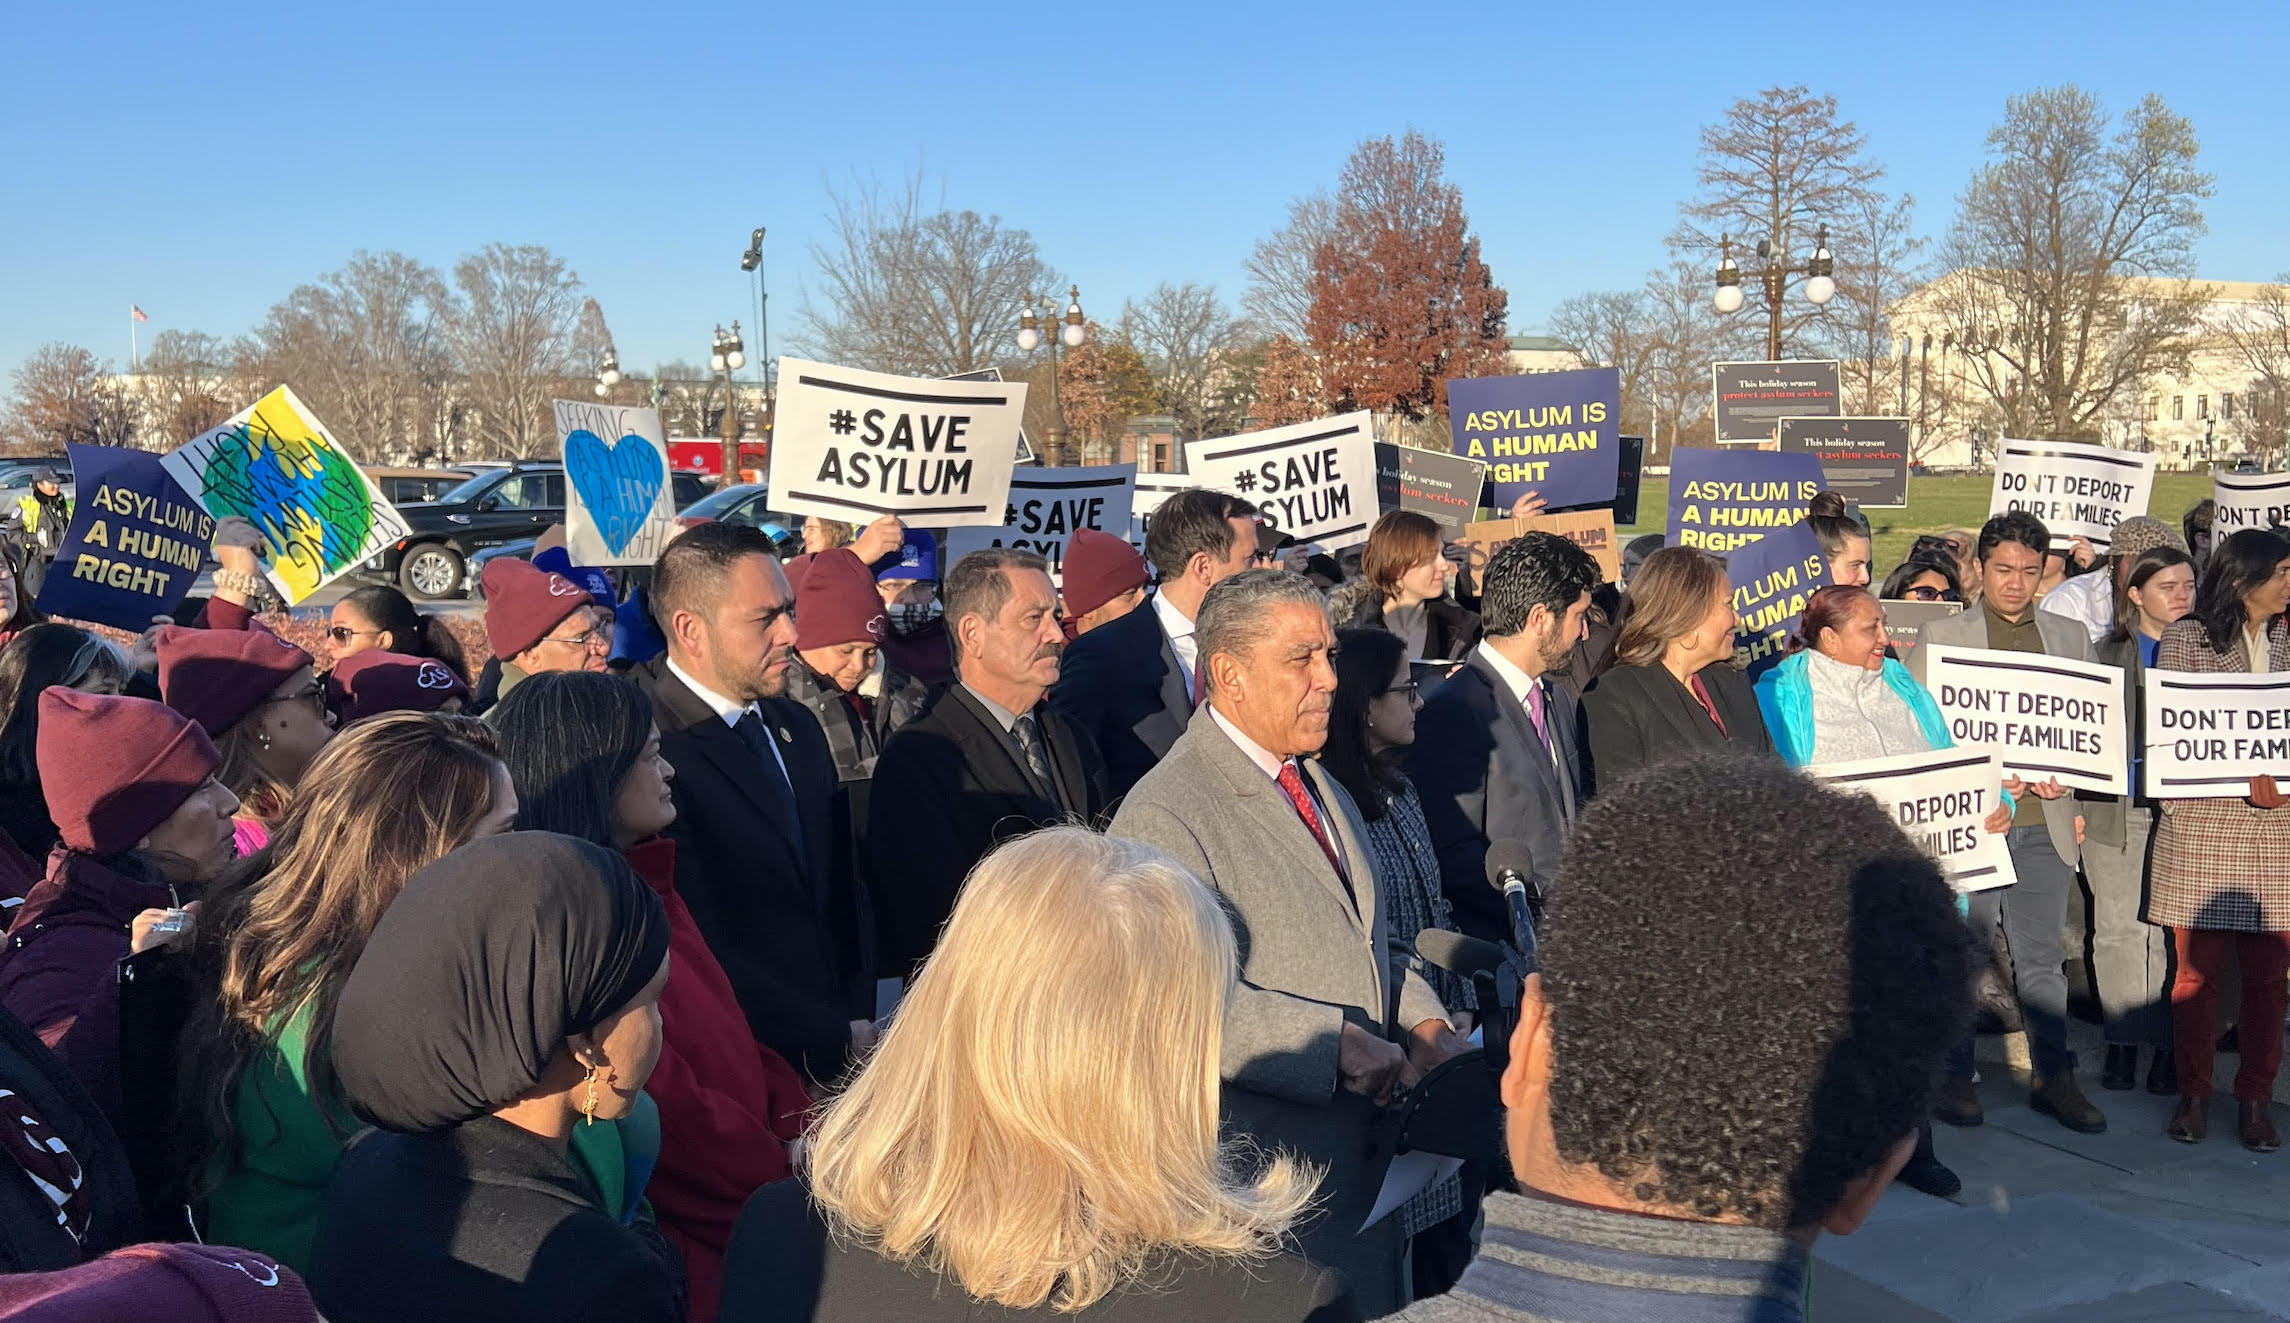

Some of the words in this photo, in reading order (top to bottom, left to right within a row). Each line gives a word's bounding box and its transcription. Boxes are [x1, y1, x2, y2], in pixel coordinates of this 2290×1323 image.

[1723, 391, 1758, 402] protect
[1761, 390, 1795, 400] asylum
[1797, 389, 1834, 398] seekers
[1738, 380, 1758, 388] This
[1759, 379, 1788, 389] holiday
[557, 400, 637, 449] SEEKING
[829, 408, 971, 454] #SAVE
[1464, 405, 1572, 432] ASYLUM
[1582, 402, 1607, 424] IS
[179, 409, 286, 498] RIGHT
[1467, 438, 1487, 457] A
[1492, 429, 1598, 458] HUMAN
[1803, 437, 1823, 447] This
[1825, 437, 1855, 449] holiday
[1825, 449, 1862, 461] asylum
[1864, 449, 1902, 460] seekers
[816, 447, 973, 496] ASYLUM
[1234, 447, 1341, 494] #SAVE
[1382, 467, 1417, 484] holiday
[1419, 477, 1452, 490] season
[1486, 460, 1550, 484] IGHT
[260, 470, 366, 542] ASYLUM
[1258, 483, 1352, 531] SYLUM
[1425, 493, 1469, 508] seekers
[1683, 480, 1789, 501] ASYLUM
[1797, 481, 1819, 501] IS
[2063, 476, 2135, 504] DEPORT
[92, 484, 194, 534] ASYLUM
[196, 513, 212, 541] IS
[1681, 504, 1702, 525] A
[83, 520, 109, 548] A
[117, 526, 201, 573] HUMAN
[284, 500, 404, 590] SEEKING
[72, 553, 171, 598] RIGHT
[1731, 566, 1799, 611] YLUM
[1803, 555, 1822, 580] IS
[1941, 684, 2010, 713] DON'T
[2018, 692, 2108, 725] DEPORT
[2161, 707, 2238, 730] DON'T
[1953, 718, 1999, 743] OUR
[2005, 723, 2102, 755] FAMILIES
[2175, 739, 2227, 760] OUR
[1899, 788, 1986, 827] DEPORT
